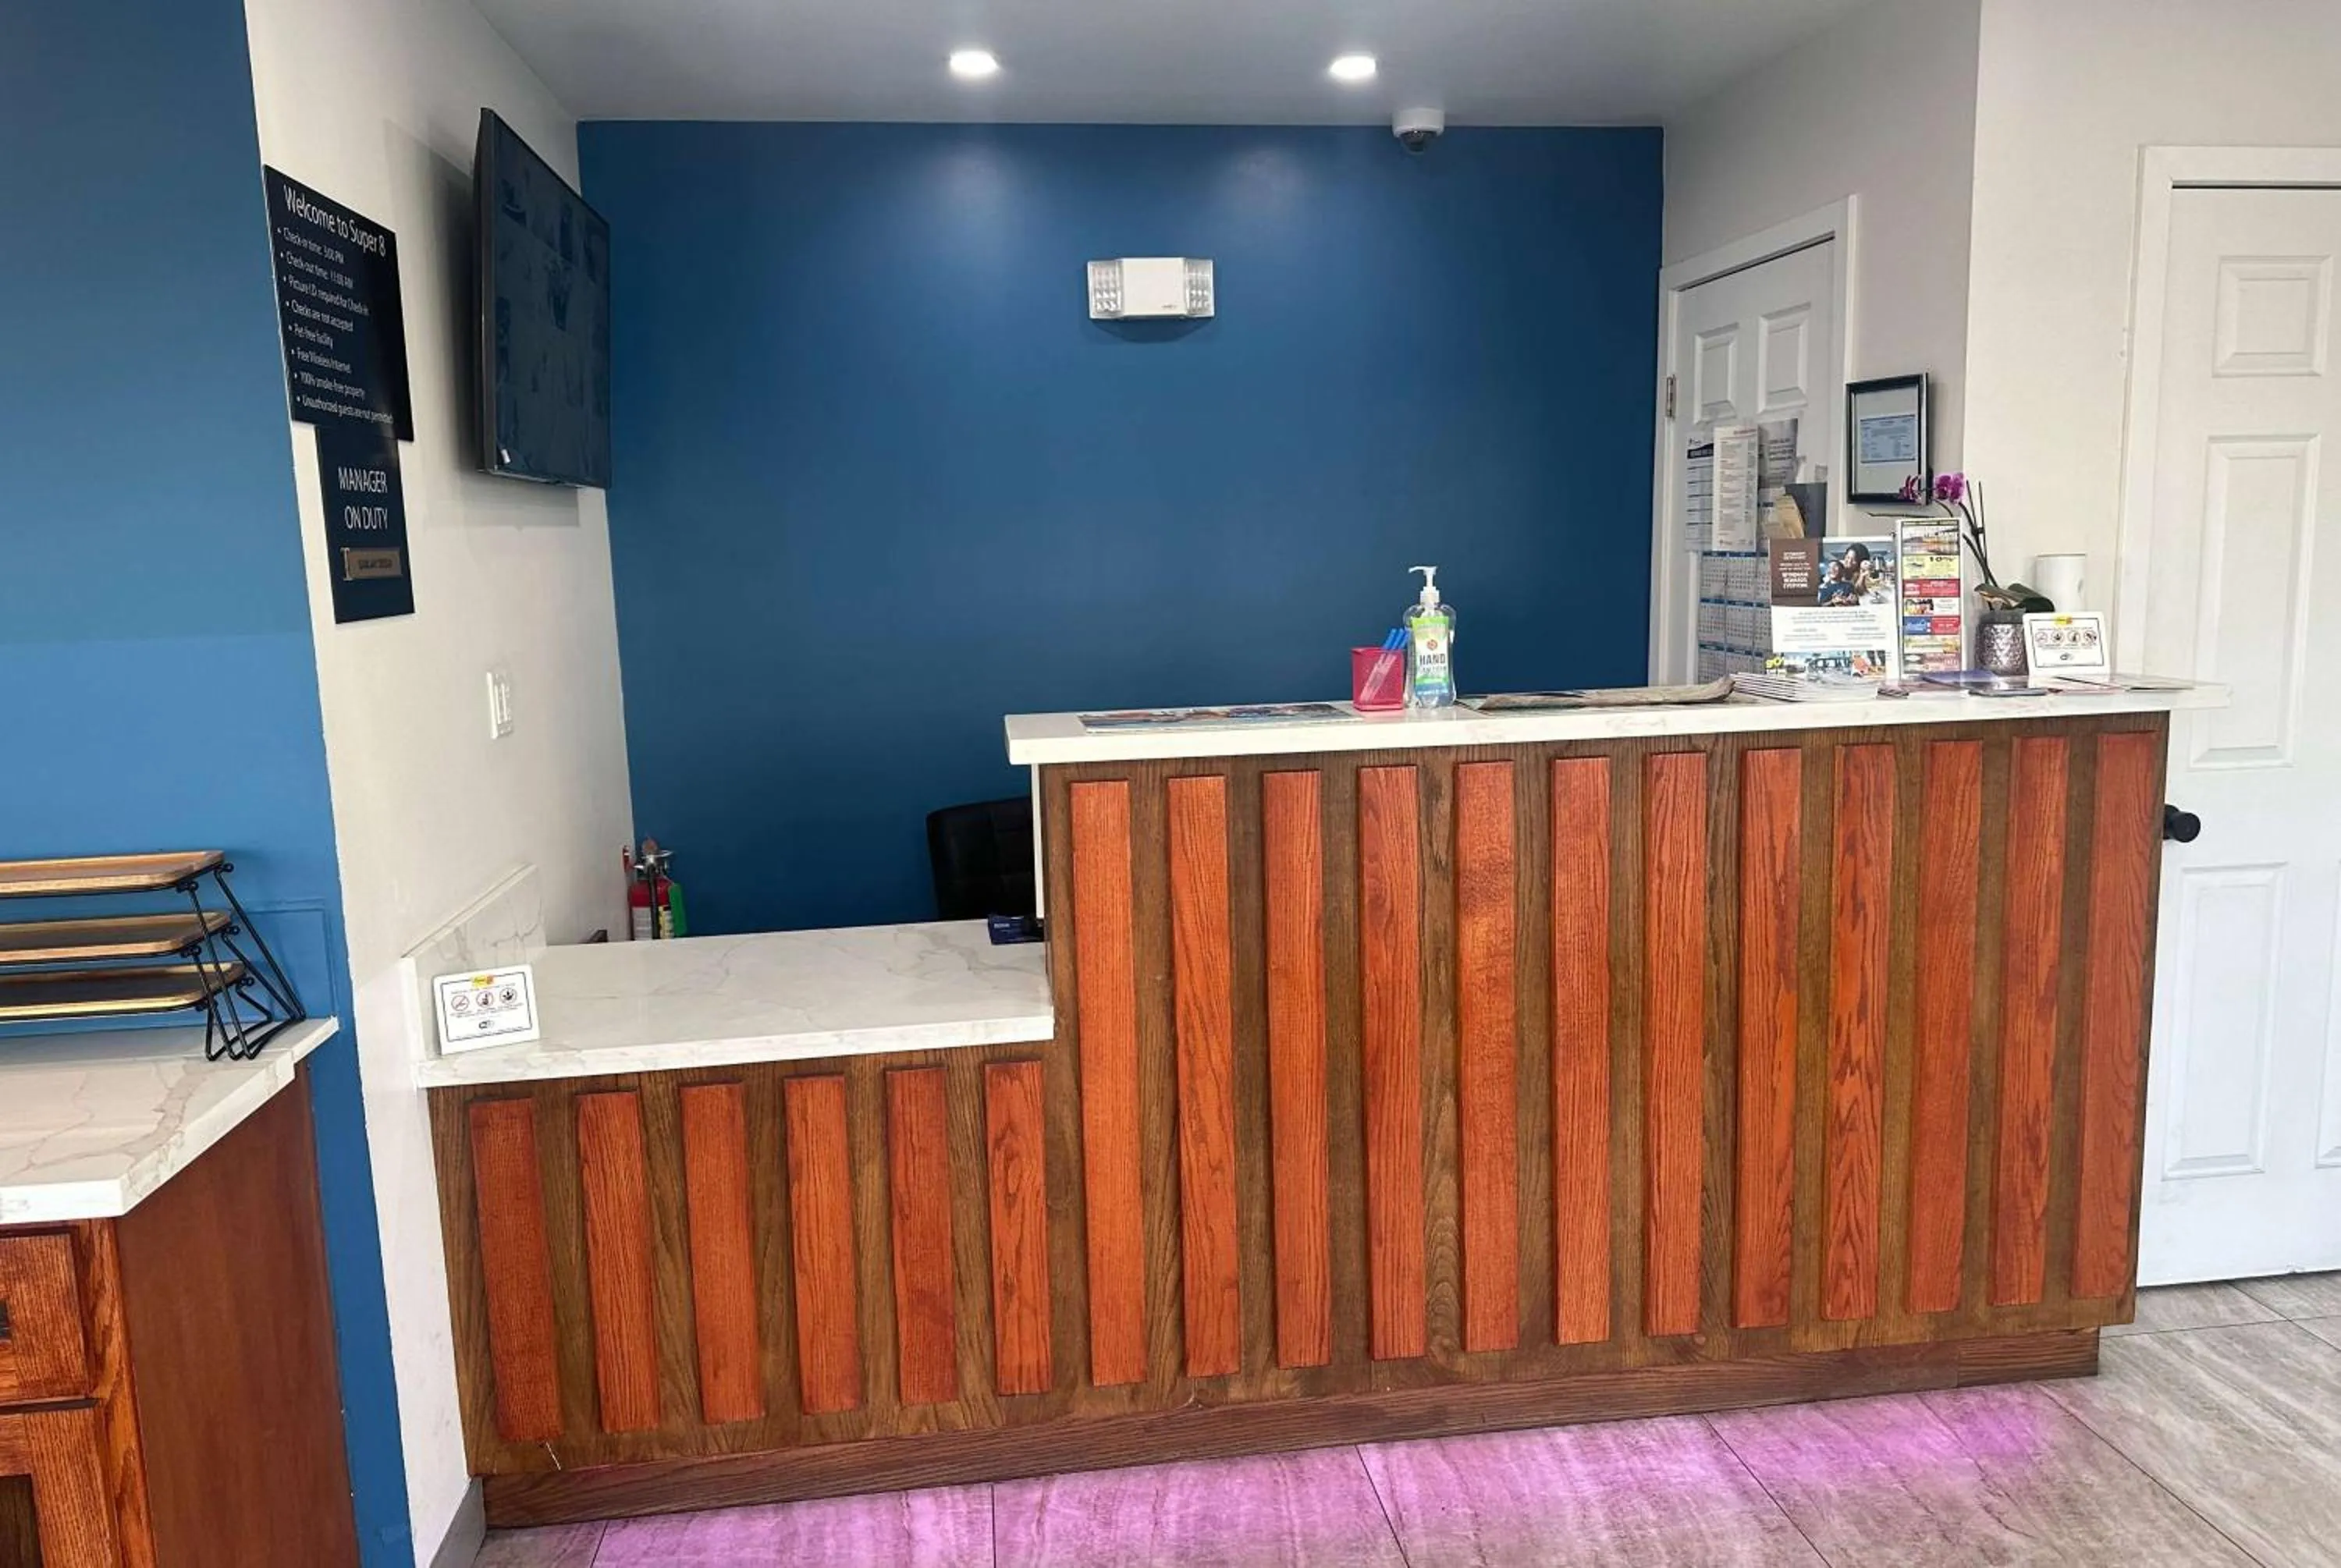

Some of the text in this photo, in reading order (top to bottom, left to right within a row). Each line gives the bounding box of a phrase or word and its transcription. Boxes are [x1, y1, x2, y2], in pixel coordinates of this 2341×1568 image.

[283, 184, 386, 257] Welcome to Super 8
[338, 466, 388, 493] MANAGER
[344, 506, 388, 530] ON DUTY
[1419, 653, 1446, 665] HAND
